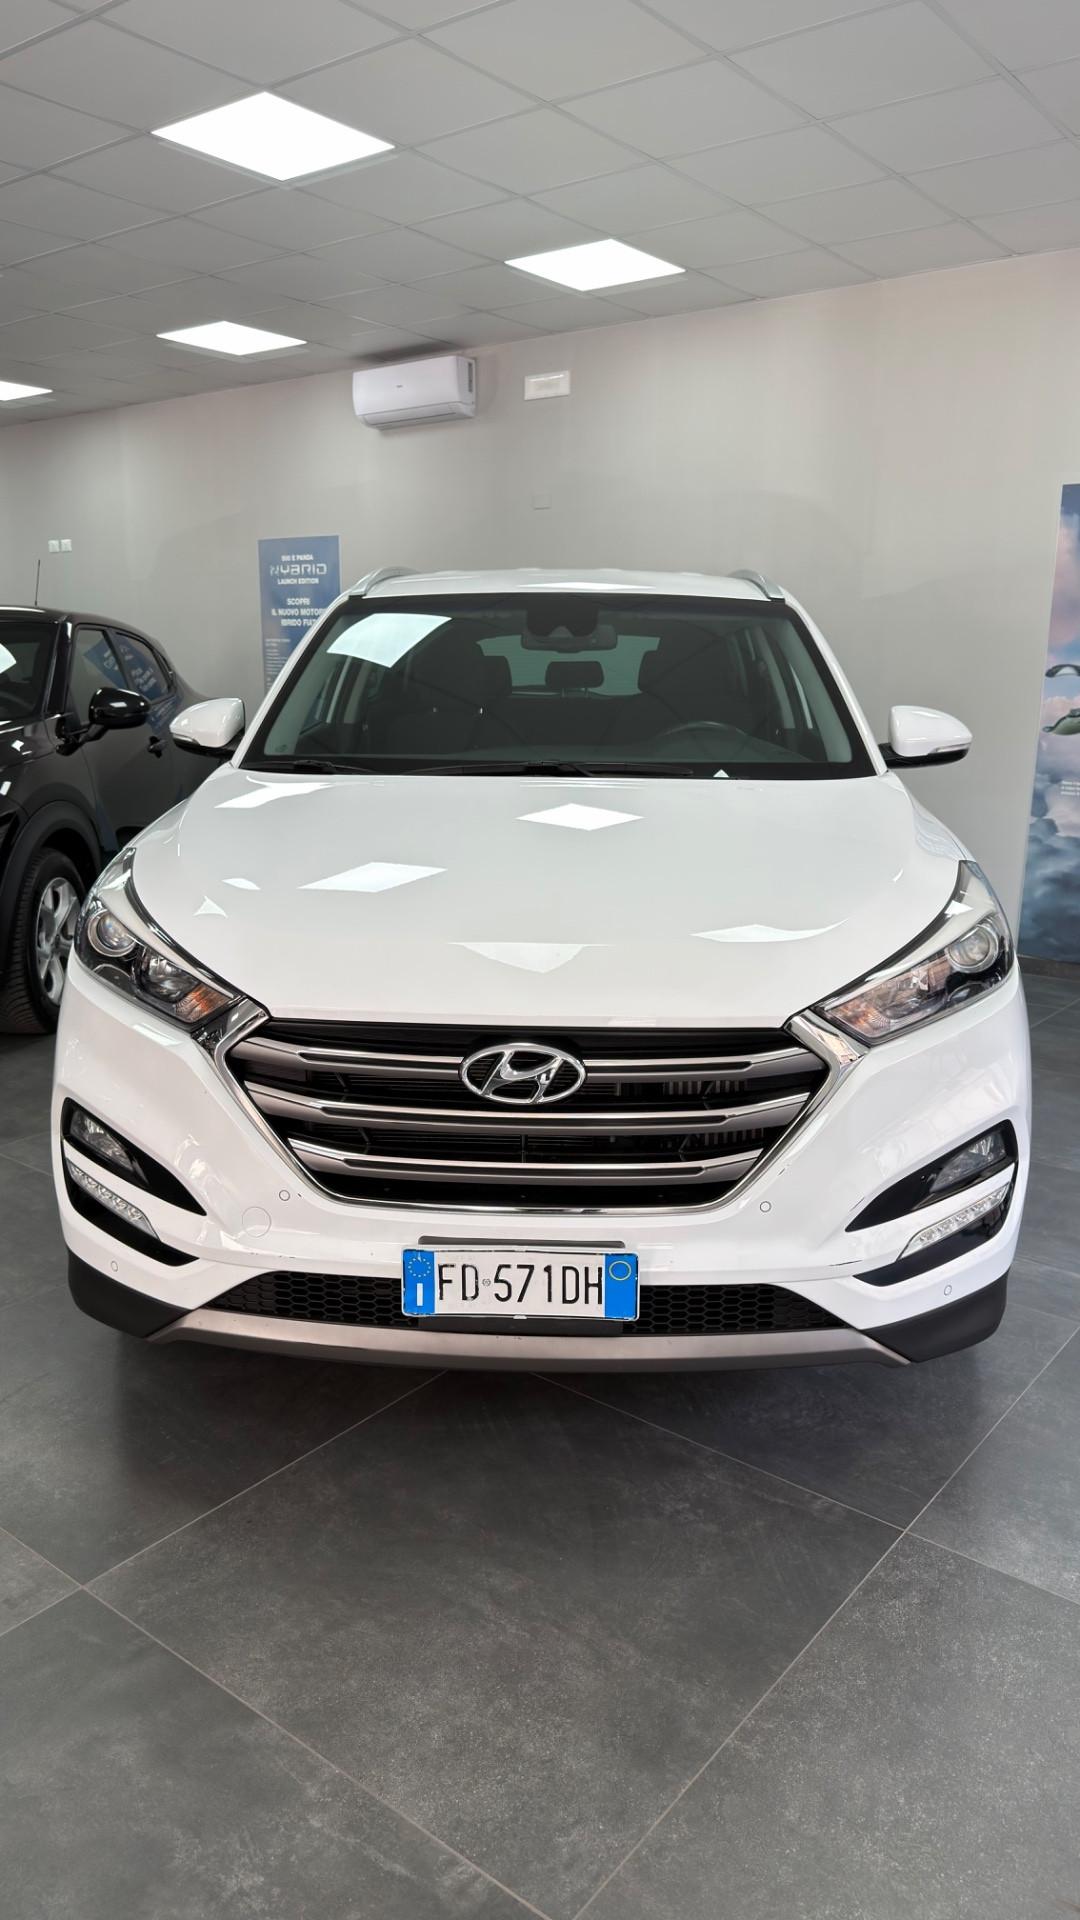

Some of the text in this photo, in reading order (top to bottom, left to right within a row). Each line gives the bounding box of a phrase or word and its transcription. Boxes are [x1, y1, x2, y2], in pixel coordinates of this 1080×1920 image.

[270, 563, 327, 576] HYBRID
[298, 577, 320, 585] EDITION
[287, 598, 311, 606] SCOPRI
[278, 608, 299, 616] NUOVO
[280, 619, 302, 627] IBRIDO
[437, 1264, 479, 1301] FD
[494, 1264, 603, 1304] 571DH
